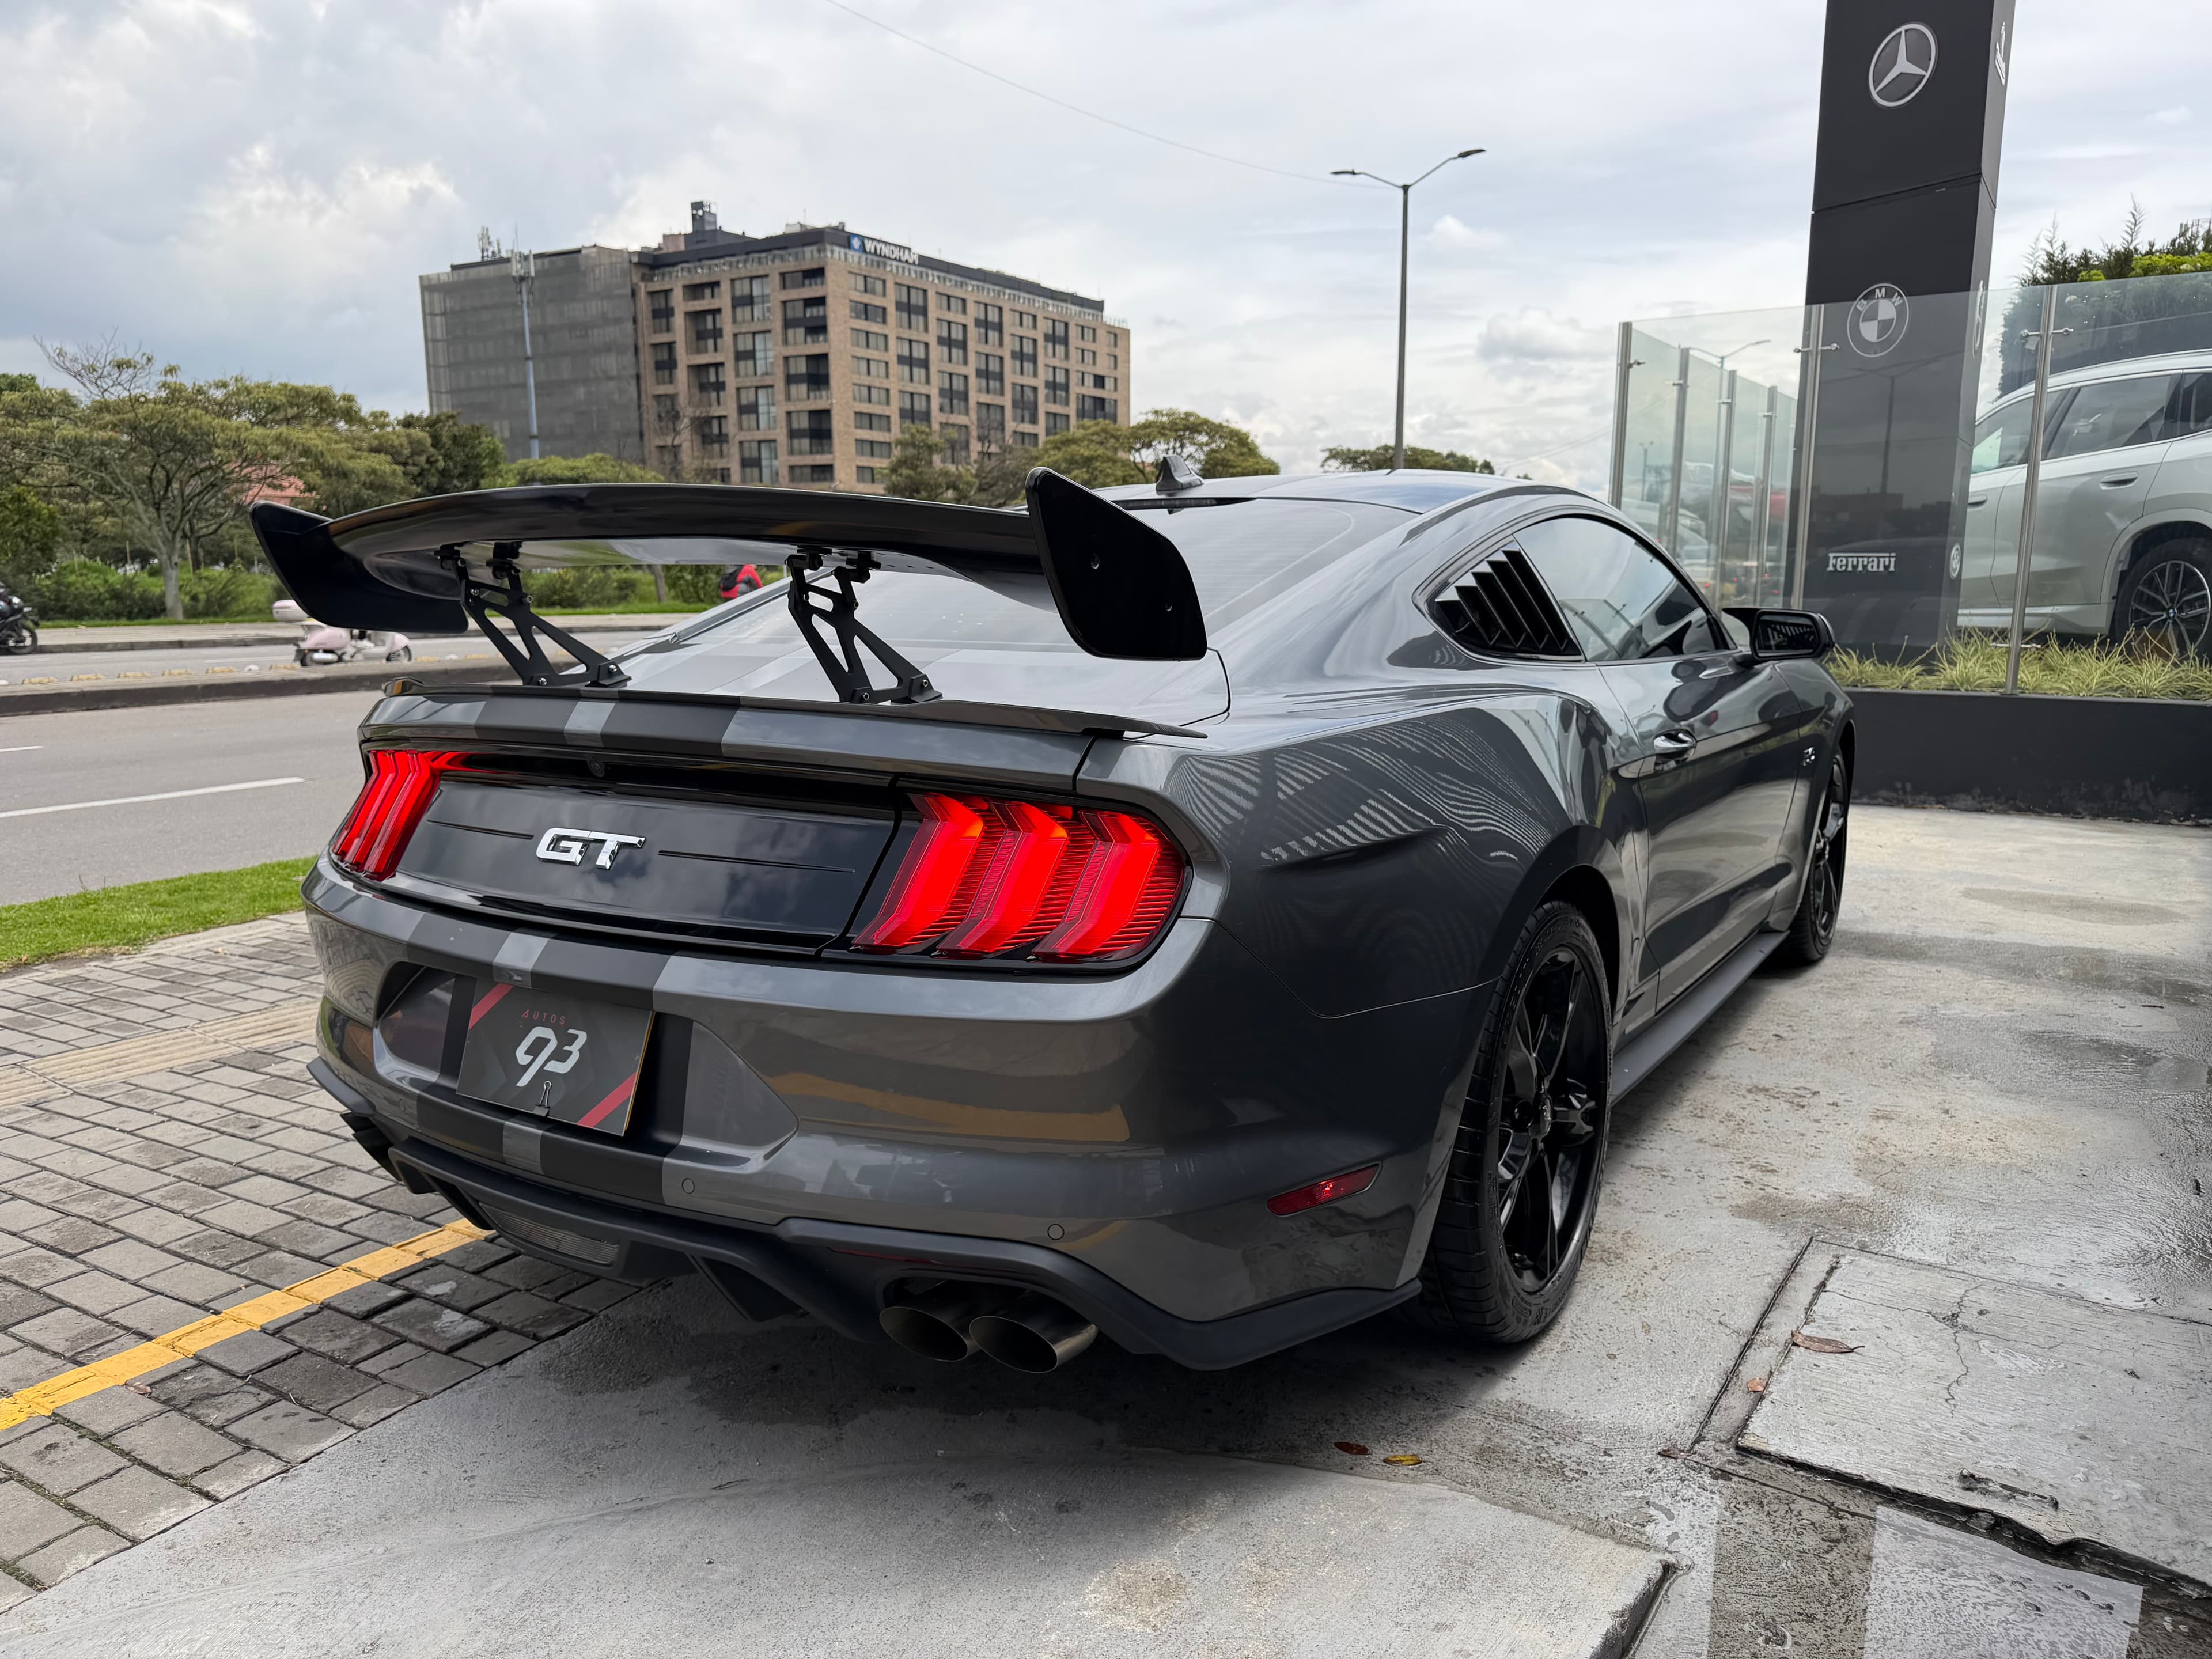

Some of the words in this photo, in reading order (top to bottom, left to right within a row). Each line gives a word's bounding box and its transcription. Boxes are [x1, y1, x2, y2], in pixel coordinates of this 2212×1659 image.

[864, 238, 919, 265] WYNDHAM
[1826, 552, 1896, 571] Ferrari
[536, 827, 646, 869] GT
[521, 1009, 566, 1025] AUTOS
[516, 1026, 587, 1087] 93
